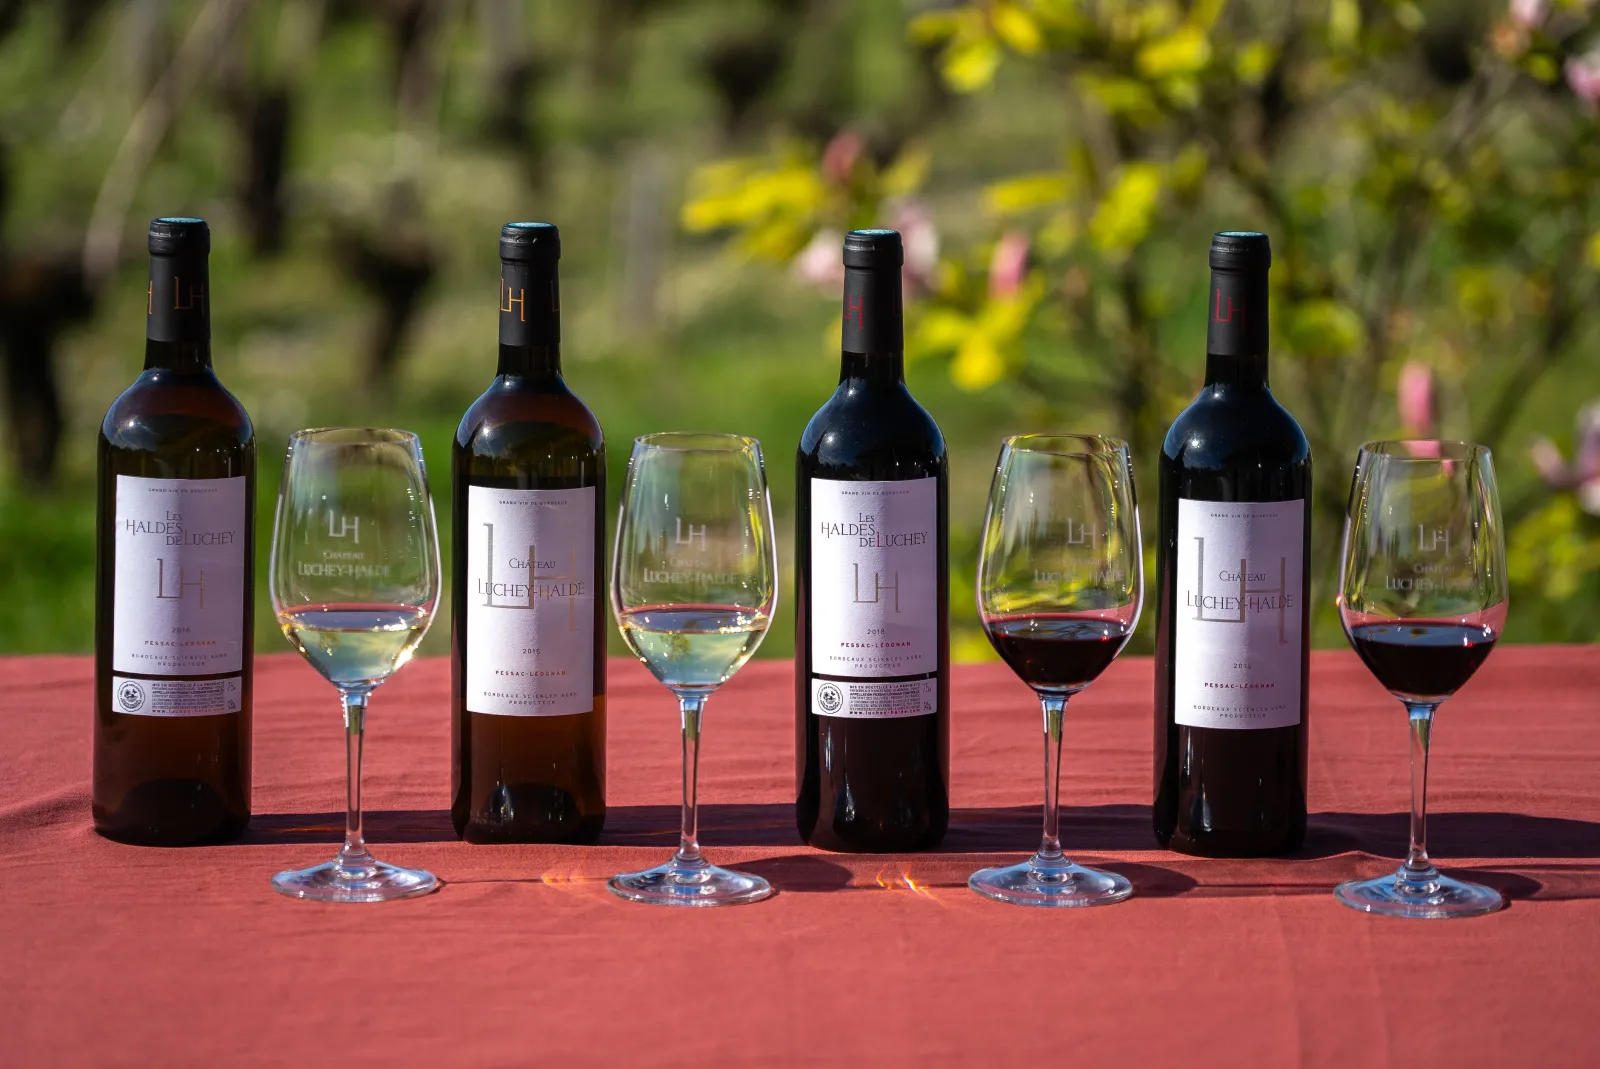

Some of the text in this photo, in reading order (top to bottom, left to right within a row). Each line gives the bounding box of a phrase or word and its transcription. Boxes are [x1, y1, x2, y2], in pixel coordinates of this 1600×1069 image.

[126, 518, 184, 536] HALDES
[327, 509, 360, 544] LH
[675, 516, 707, 552] LH
[821, 521, 876, 539] HALDES
[183, 529, 236, 546] LUCHEY
[876, 531, 928, 548] LUCHEY
[478, 577, 585, 601] LUCHEY-HALDE
[1187, 589, 1294, 613] LUCHEY-HALDE
